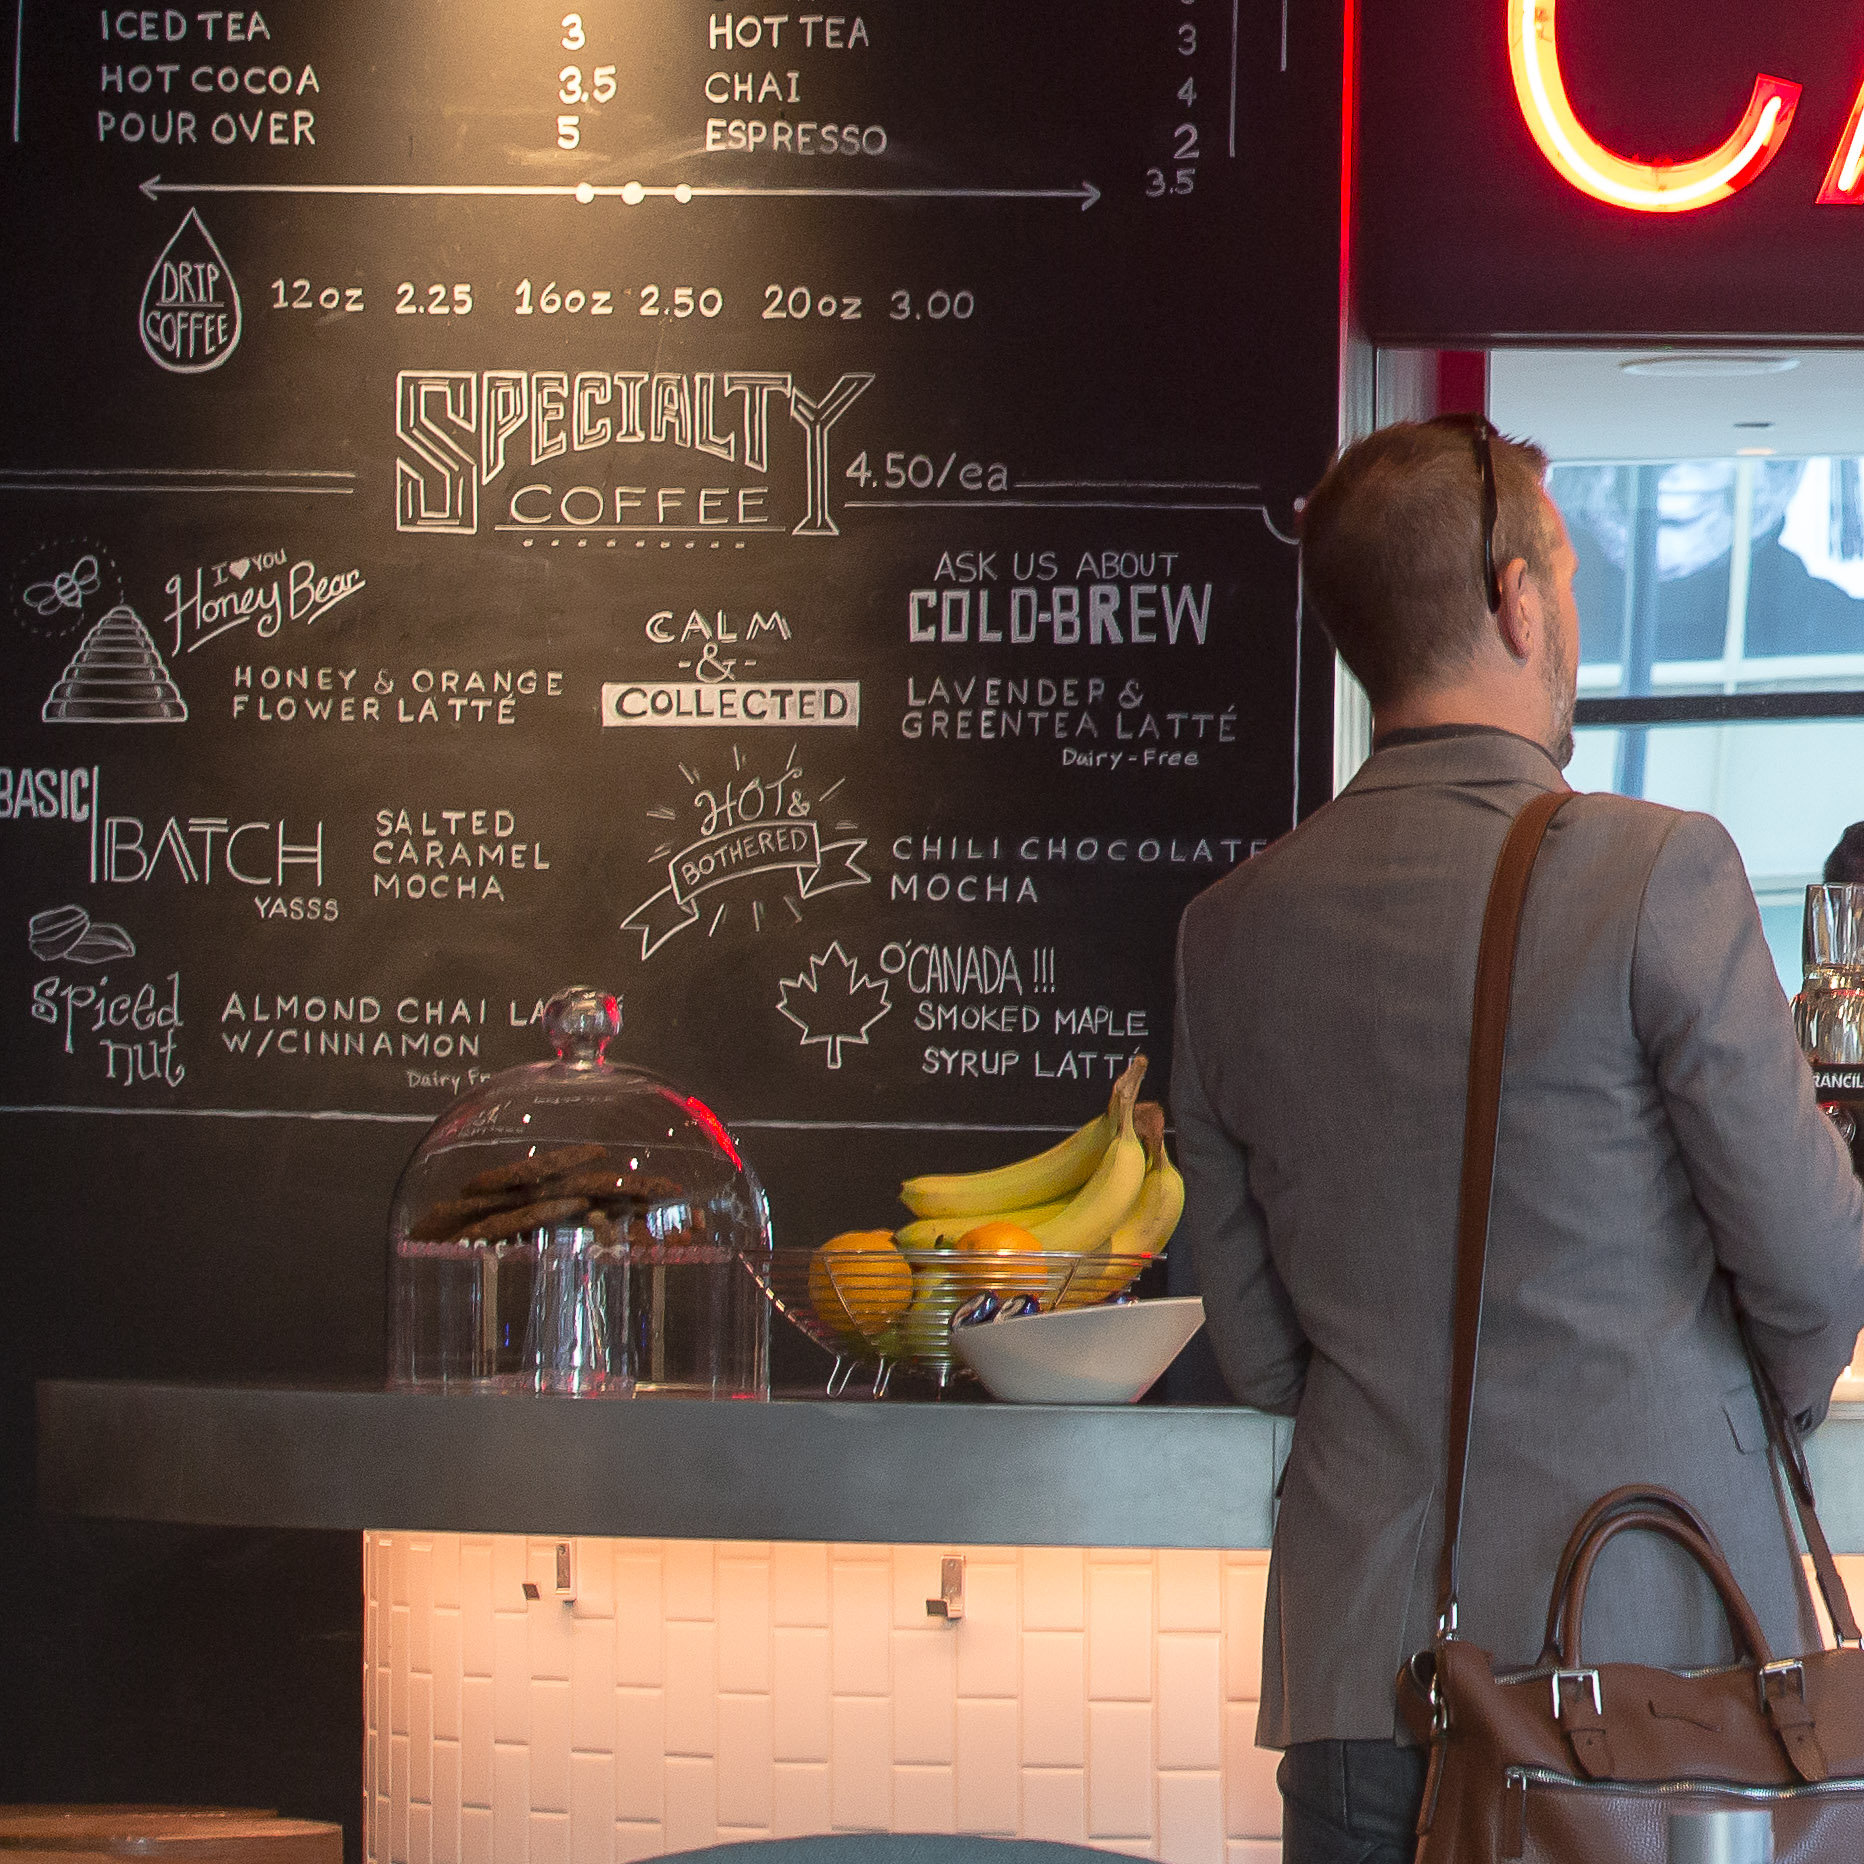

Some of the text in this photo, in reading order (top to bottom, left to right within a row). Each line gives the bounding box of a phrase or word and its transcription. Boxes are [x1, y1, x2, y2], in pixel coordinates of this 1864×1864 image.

[101, 10, 270, 41] ICED TEA
[710, 14, 868, 49] HOT TEA
[101, 64, 616, 103] HOT COCOA 3.5
[97, 110, 315, 145] POUR OVER
[704, 118, 888, 155] ESPRESSO
[161, 261, 220, 304] DRIP
[271, 279, 974, 320] 12oz 2.25 16oz 2.50 20oz 3.00
[145, 312, 230, 359] COFFEE
[394, 368, 876, 538] SPECIALTY
[508, 451, 1007, 526] COFFEE 4.50/ea
[163, 561, 365, 657] Honey Bear
[645, 610, 790, 643] CALM
[234, 666, 562, 701] HONEY ORANGE
[233, 693, 517, 726] FLOWER LATTÉ
[614, 684, 850, 724] COLLECTED
[1115, 704, 1237, 742] LATTÉ
[376, 810, 514, 837] SALTED
[103, 817, 322, 886] BATCH
[373, 840, 549, 870] CARAMEL
[681, 830, 808, 886] BOTHERED
[892, 836, 999, 860] CHILI
[374, 874, 504, 901] MOCHA
[891, 874, 1037, 903] MOCHA
[221, 992, 485, 1024] ALMOND CHAI
[914, 1002, 1148, 1036] SMOKED MAPLE
[922, 1047, 1019, 1077] SYRUP
